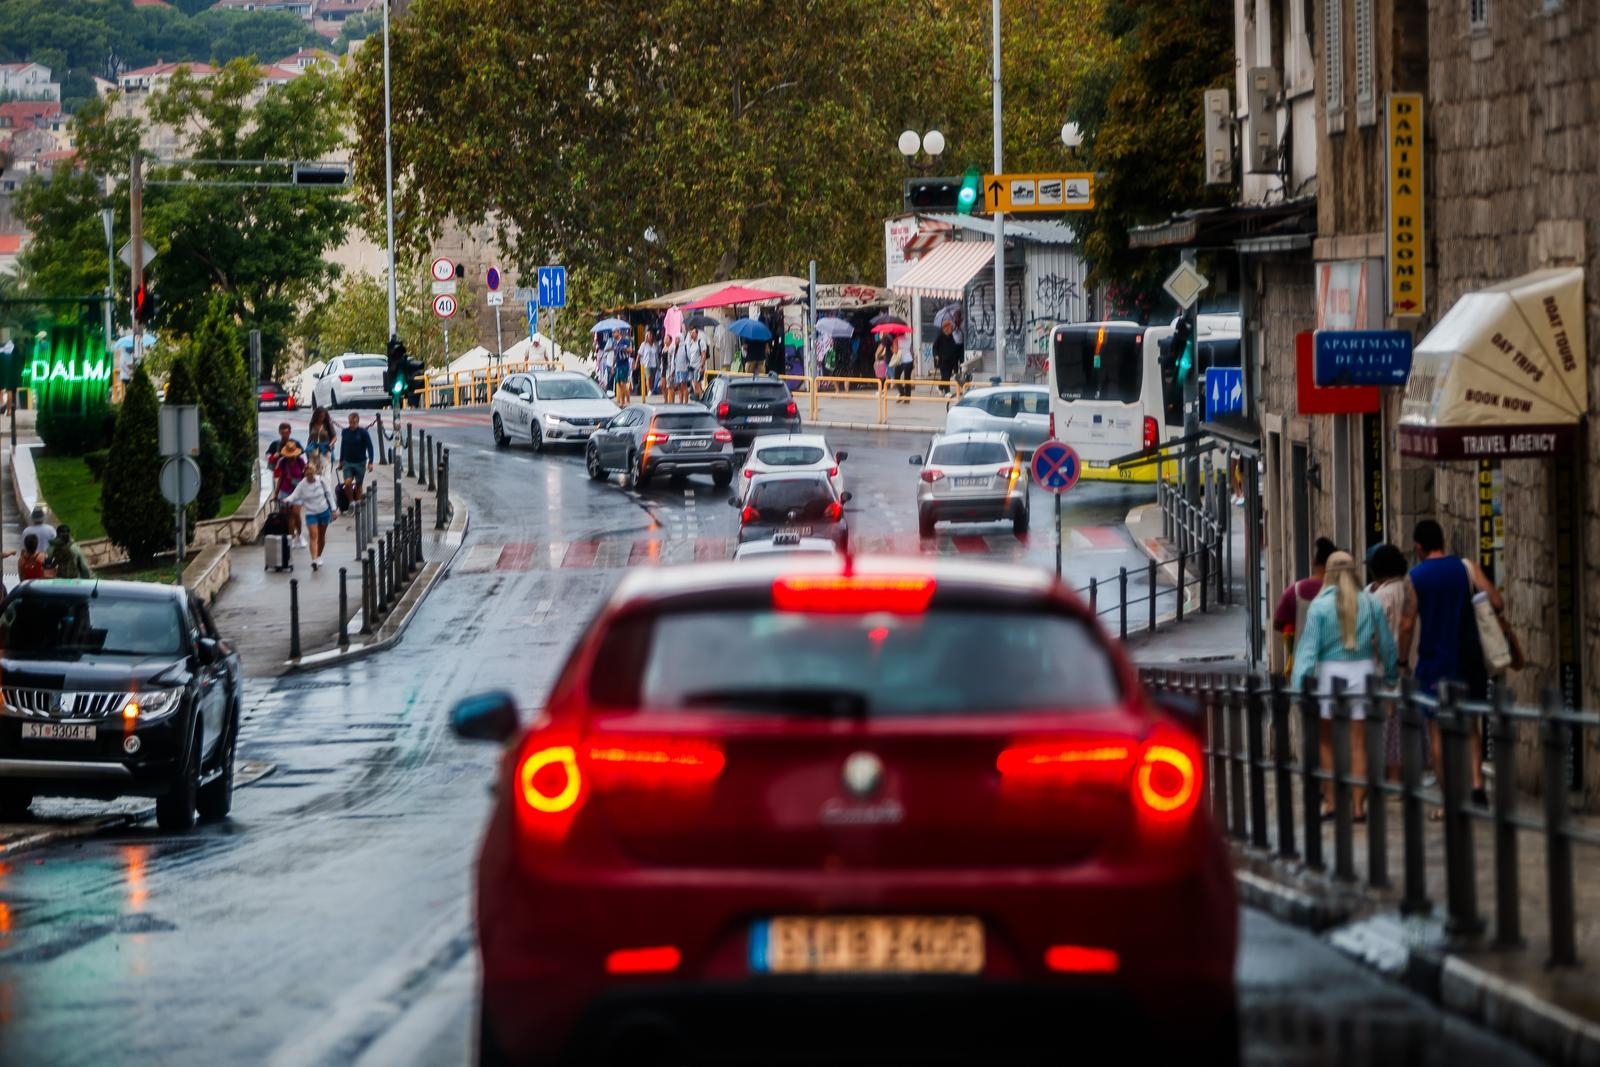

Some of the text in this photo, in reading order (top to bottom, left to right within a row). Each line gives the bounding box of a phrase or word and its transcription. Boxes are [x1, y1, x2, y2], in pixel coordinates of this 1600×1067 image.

[1395, 102, 1414, 292] DAMIRA ROOMS
[438, 300, 452, 312] 40
[1322, 338, 1406, 350] APARTMANI
[1543, 296, 1577, 373] BOAT TOURS
[1335, 354, 1364, 365] DEA
[1490, 332, 1545, 384] DAY TRIPS
[1464, 388, 1534, 414] BOOK NOW
[1461, 435, 1506, 454] TRAVEL
[1509, 433, 1557, 453] AGENCY
[1373, 469, 1383, 533] SERVIS
[31, 724, 44, 738] ST
